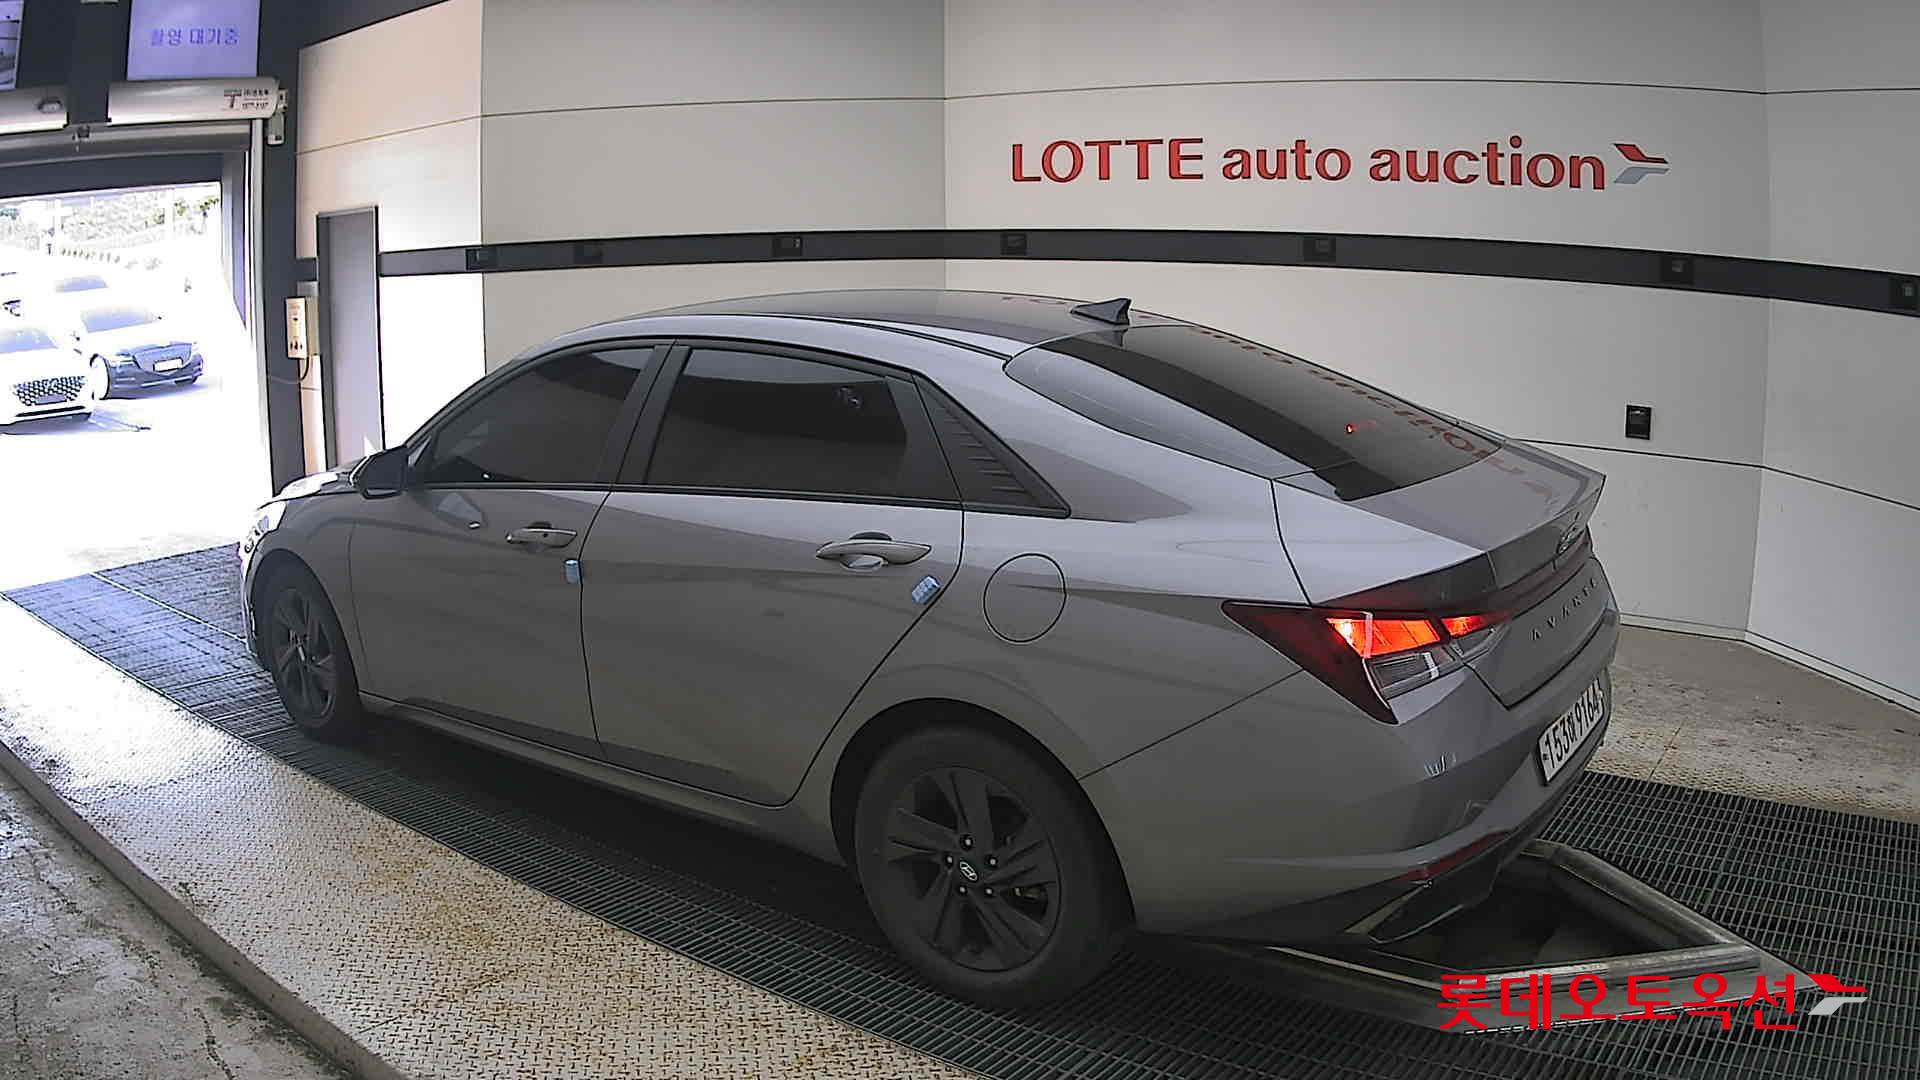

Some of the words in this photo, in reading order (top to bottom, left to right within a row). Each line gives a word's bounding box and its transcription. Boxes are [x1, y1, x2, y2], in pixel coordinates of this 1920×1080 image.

[1012, 138, 1204, 182] LOTTE
[1222, 139, 1352, 182] auto
[1369, 135, 1606, 190] auction
